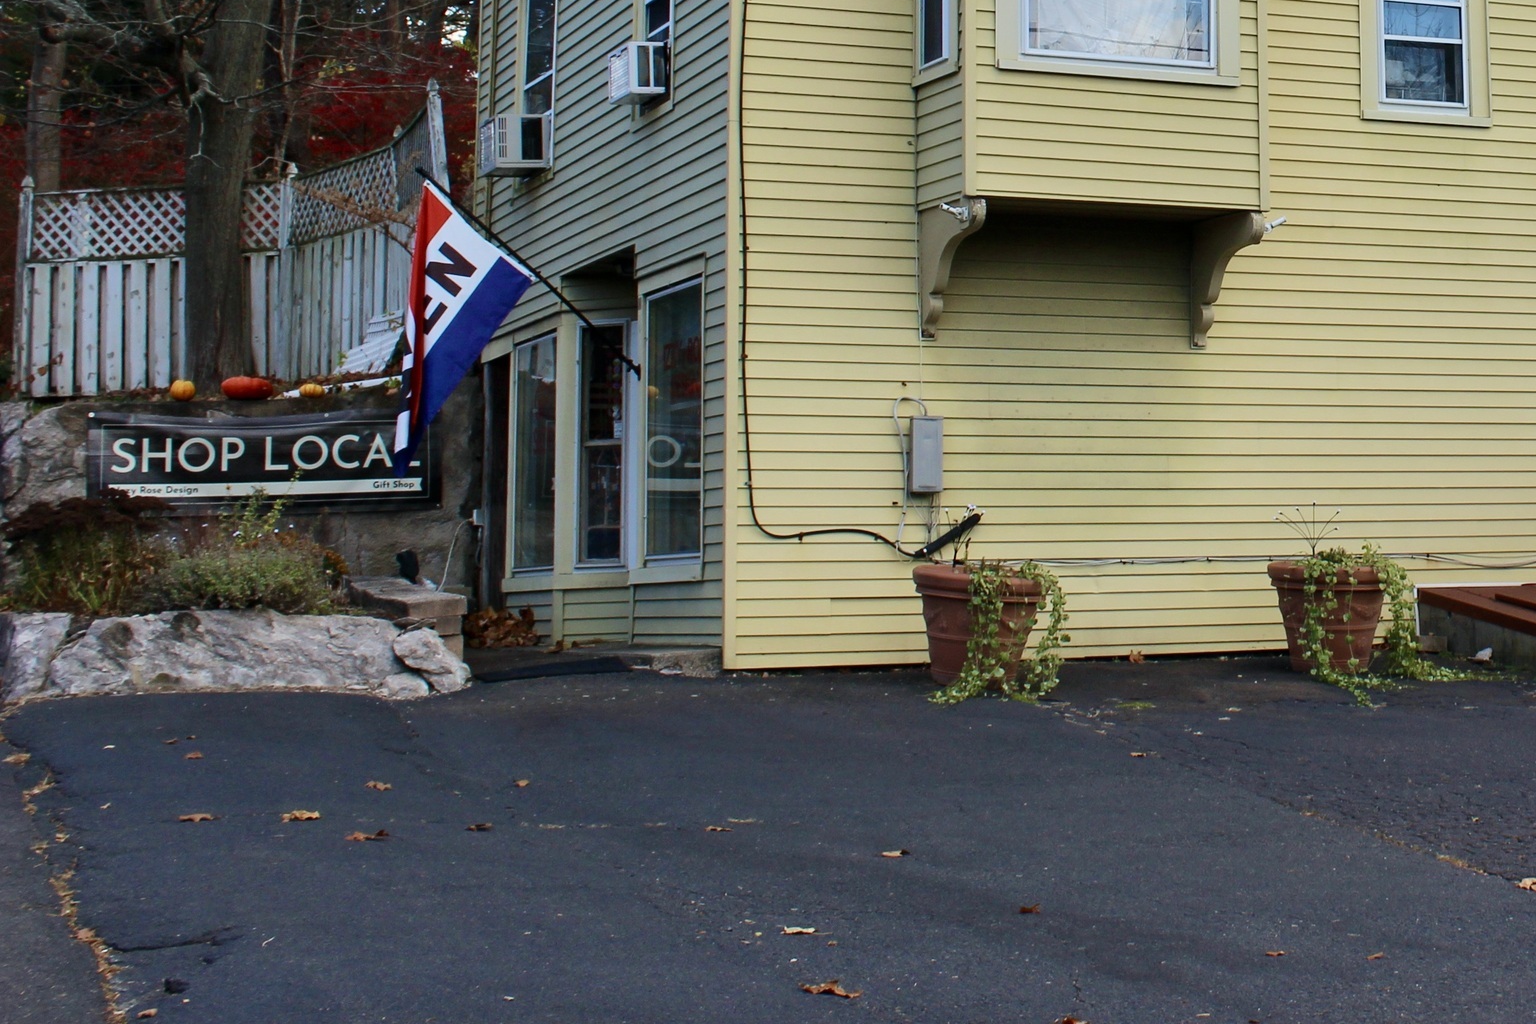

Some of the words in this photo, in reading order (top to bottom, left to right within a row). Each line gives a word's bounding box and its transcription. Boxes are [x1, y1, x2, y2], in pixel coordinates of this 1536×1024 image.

[110, 437, 245, 474] SHOP
[264, 433, 420, 471] LOCA
[373, 480, 390, 489] Gift
[393, 480, 414, 489] Shop
[140, 486, 162, 494] Rose
[166, 485, 199, 496] Design
